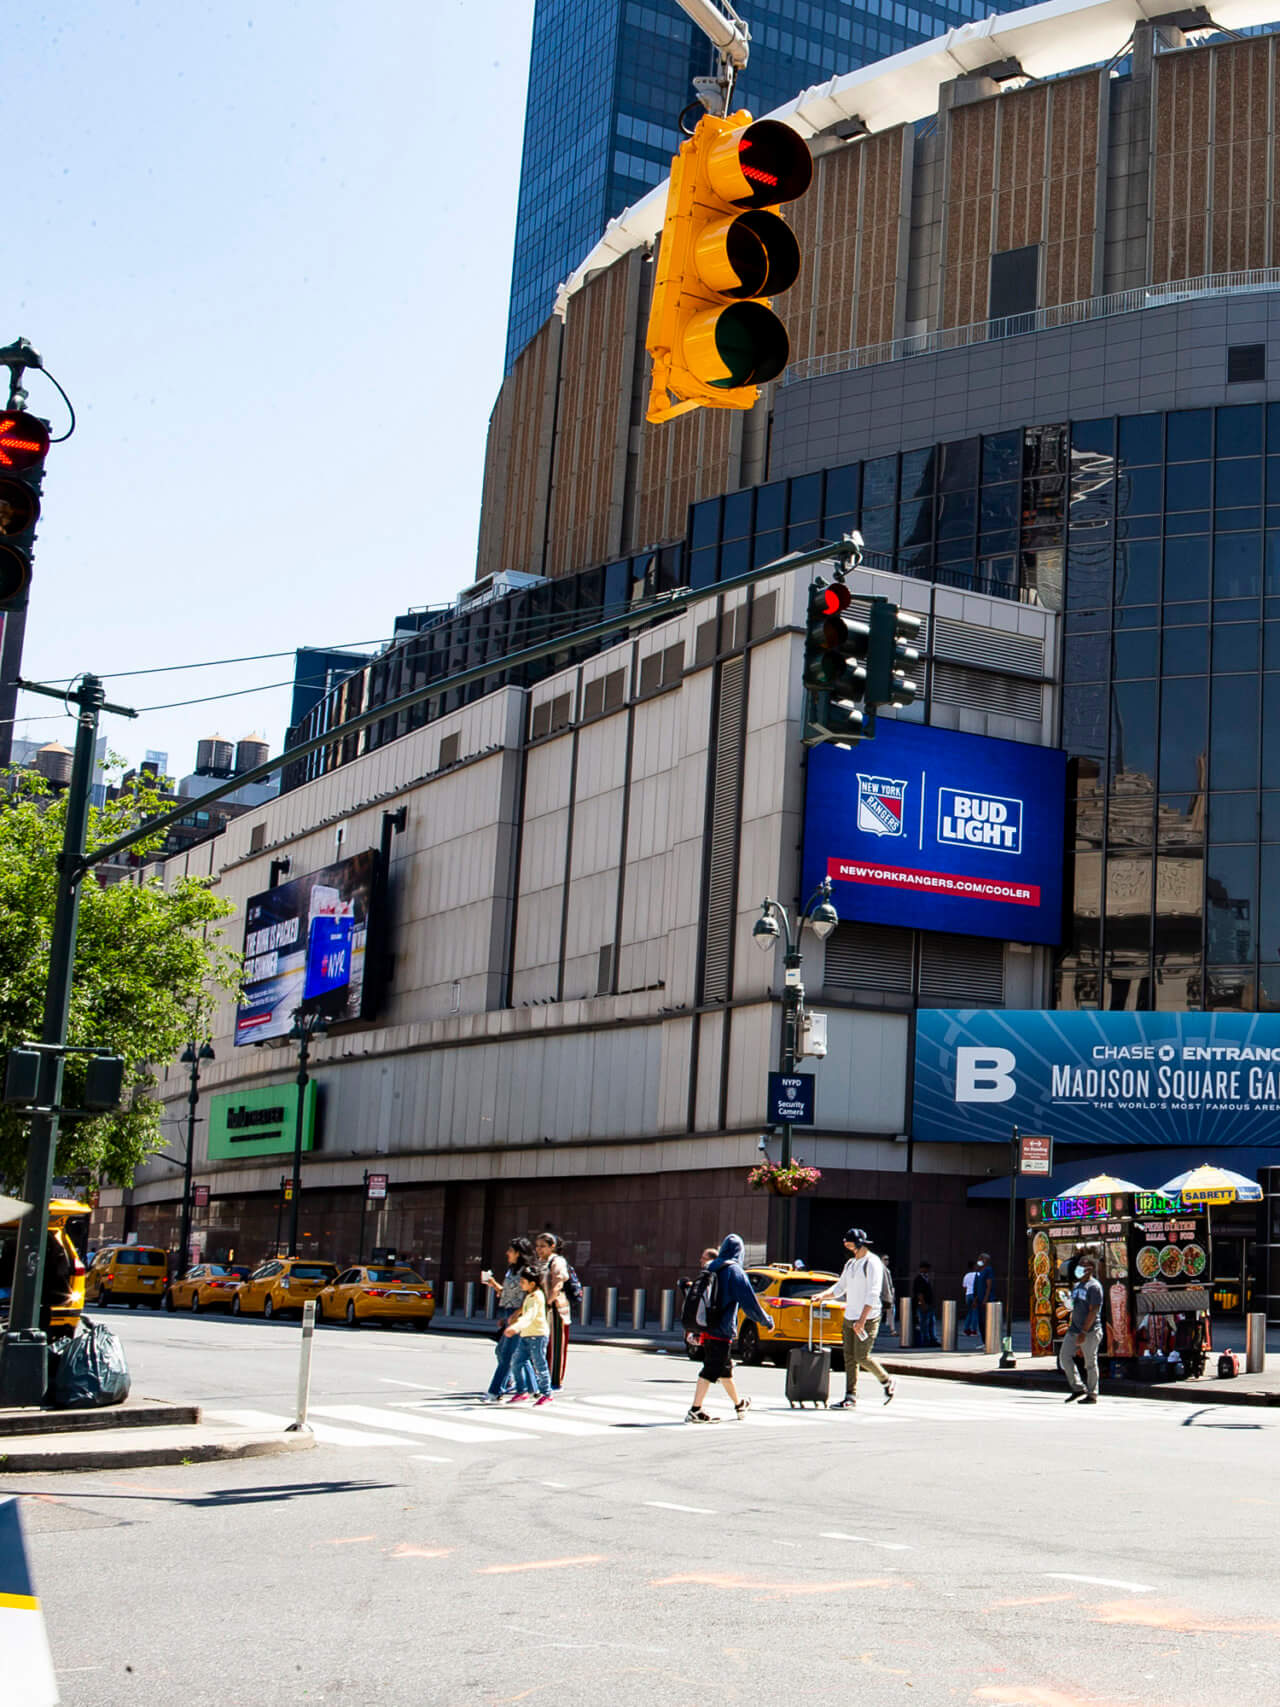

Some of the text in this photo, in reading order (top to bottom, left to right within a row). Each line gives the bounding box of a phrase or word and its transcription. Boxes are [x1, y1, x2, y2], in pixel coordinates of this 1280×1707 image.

[861, 781, 902, 796] NEW YORK
[866, 795, 899, 831] RANGERS
[954, 796, 1007, 823] BUD
[943, 816, 1016, 847] LIGHT
[839, 865, 1031, 899] NEWYORKRANGERS.COM/COOLER
[1093, 1046, 1154, 1060] CHASE
[956, 1047, 1016, 1102] B
[778, 1100, 805, 1109] Security
[1185, 1190, 1233, 1200] SABRETT
[1052, 1199, 1090, 1217] CHEESE
